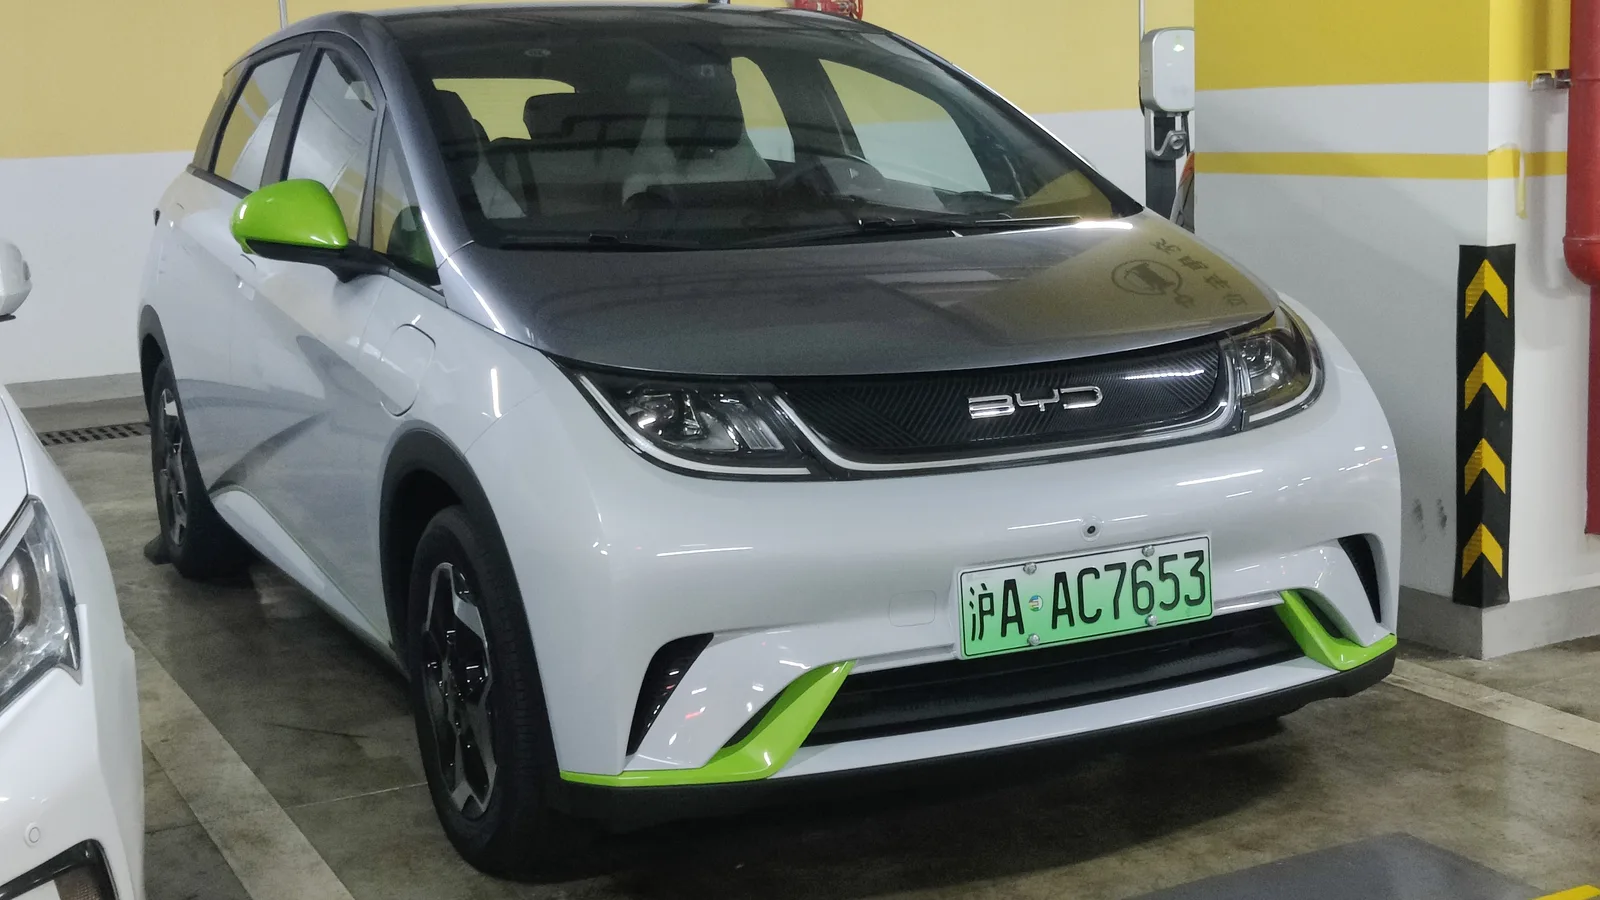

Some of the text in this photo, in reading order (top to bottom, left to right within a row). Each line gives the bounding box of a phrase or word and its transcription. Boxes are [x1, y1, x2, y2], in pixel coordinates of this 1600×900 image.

[967, 385, 1103, 420] BYD
[969, 549, 1206, 641] 沪A AC7653
